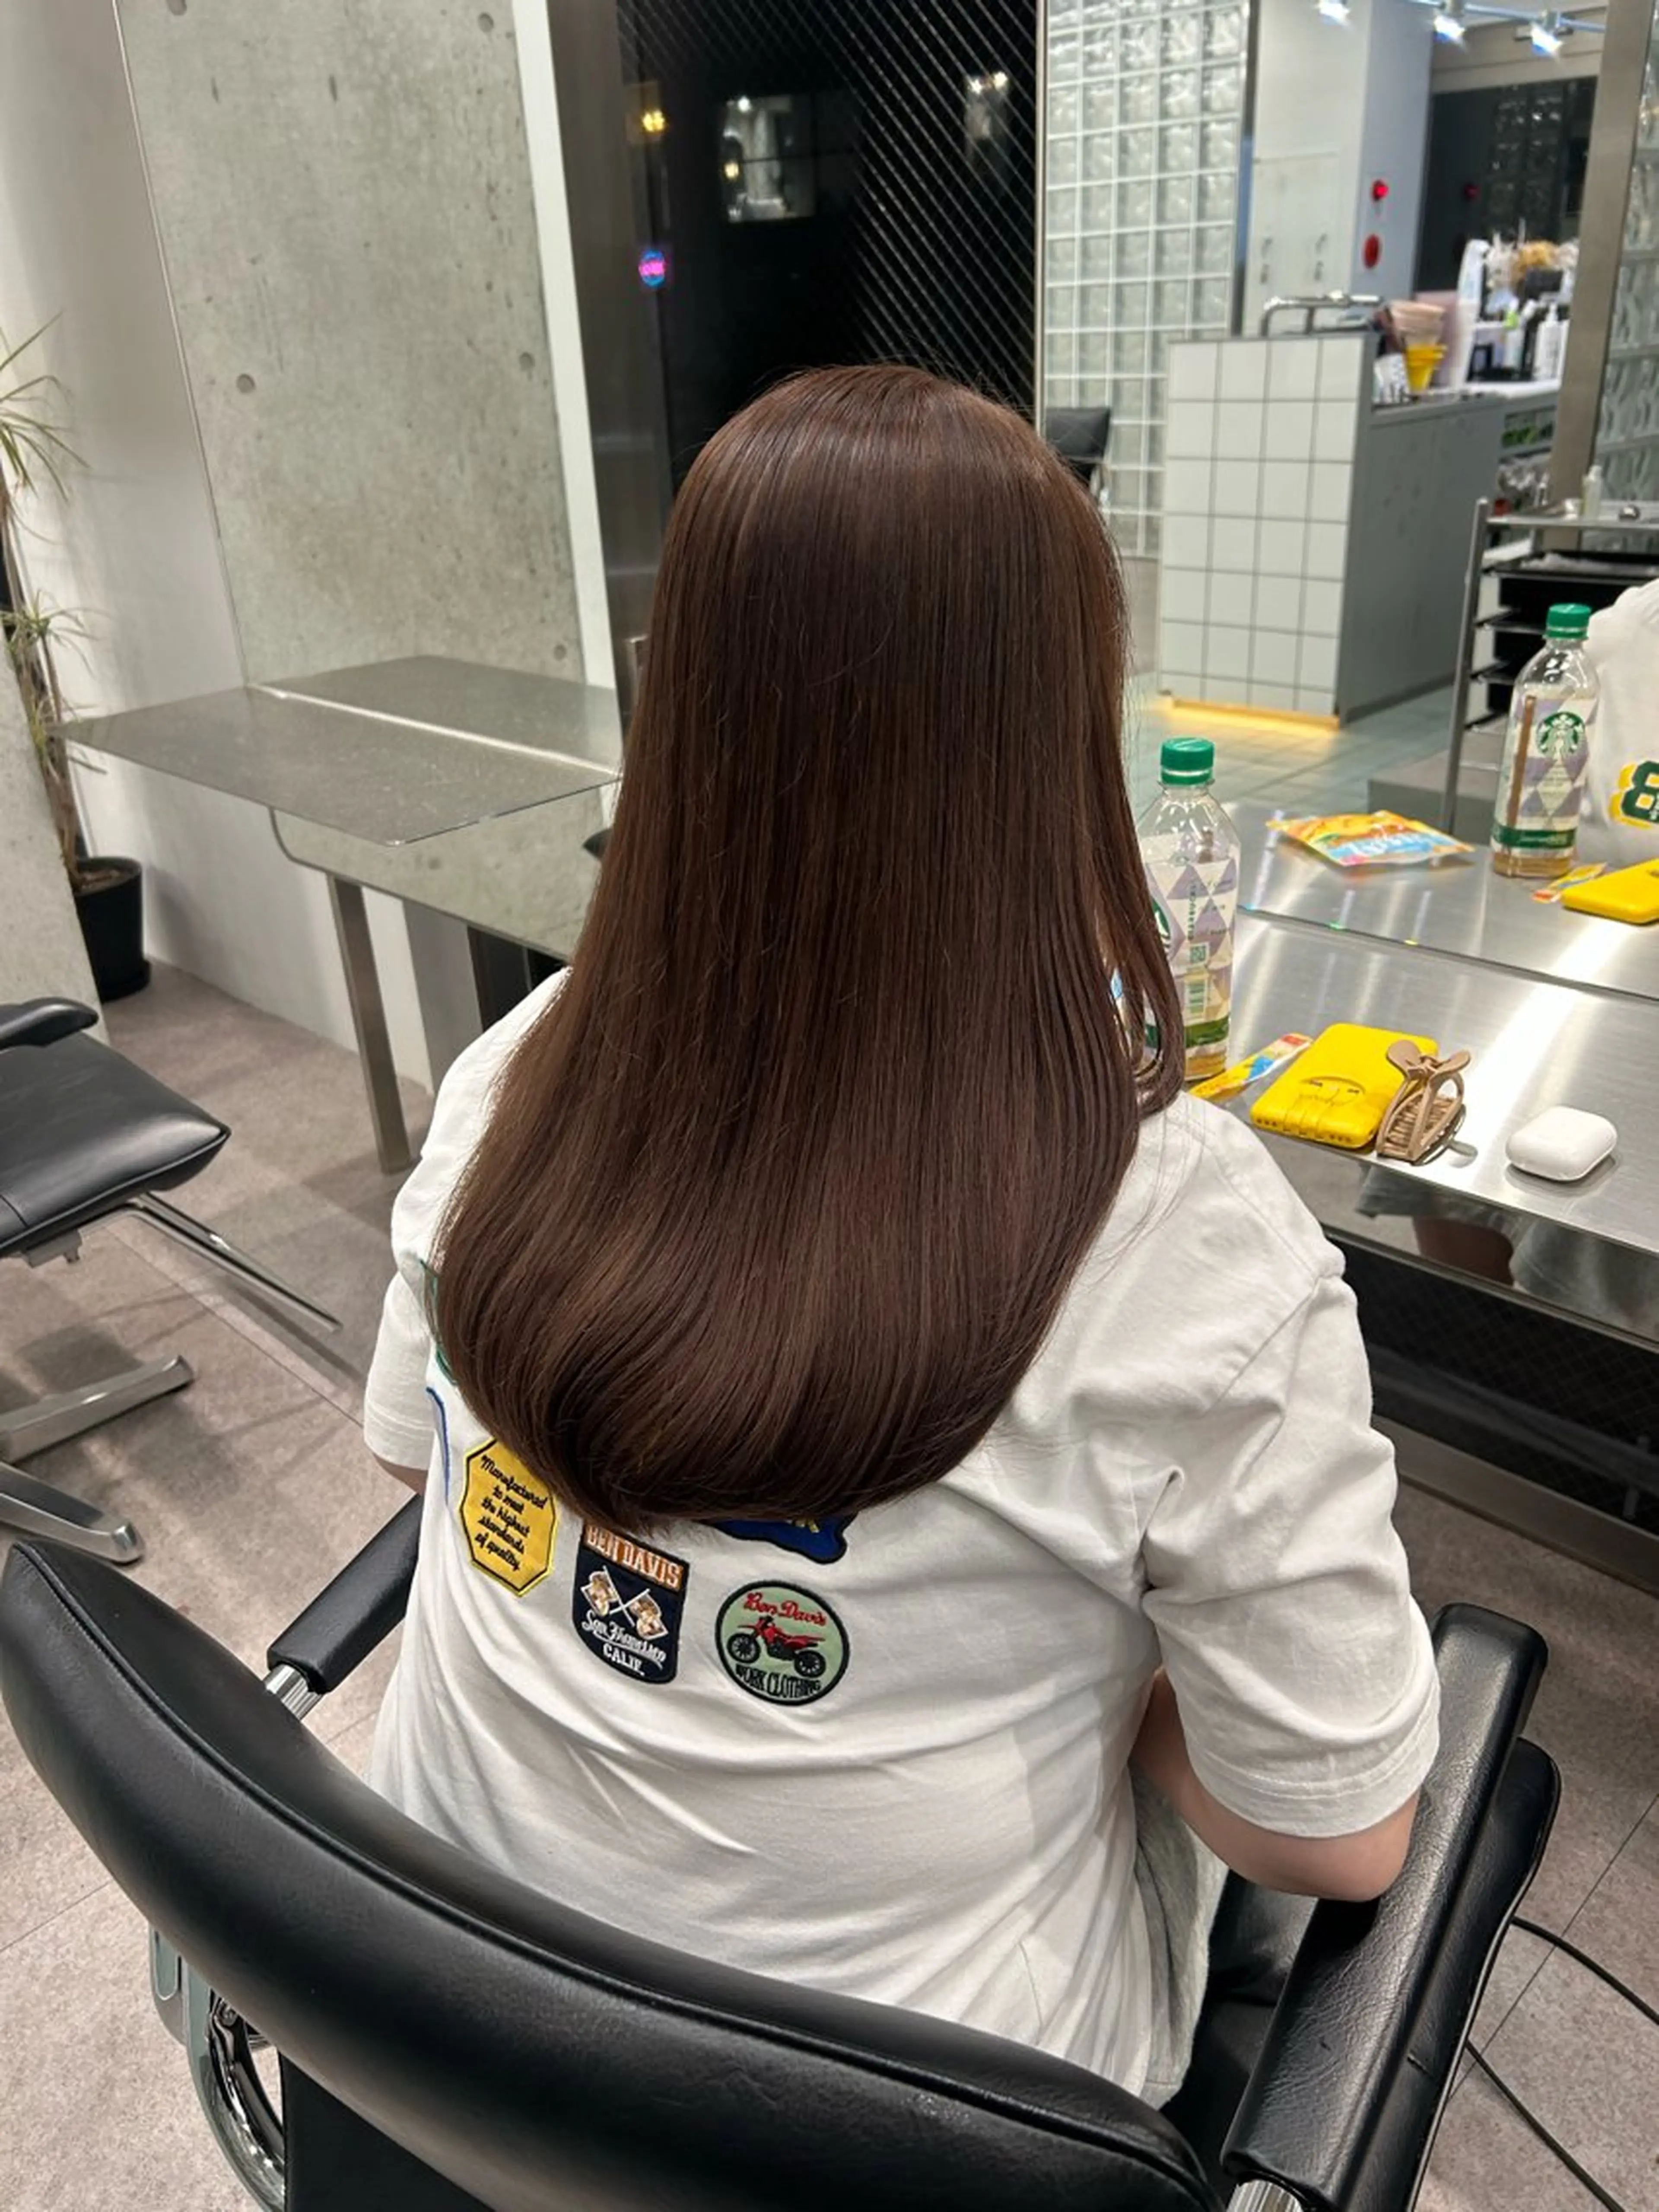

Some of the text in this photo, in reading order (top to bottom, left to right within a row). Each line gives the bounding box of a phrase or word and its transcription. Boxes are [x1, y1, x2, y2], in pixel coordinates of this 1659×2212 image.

[480, 1454, 548, 1509] Manufactured
[492, 1485, 503, 1500] to
[481, 1497, 531, 1538] the highest
[475, 1532, 489, 1548] of
[582, 1609, 609, 1637] San
[744, 1592, 826, 1626] Ben Davis
[603, 1643, 645, 1677] CALIF.
[736, 1663, 821, 1698] WORK CLOTHING
